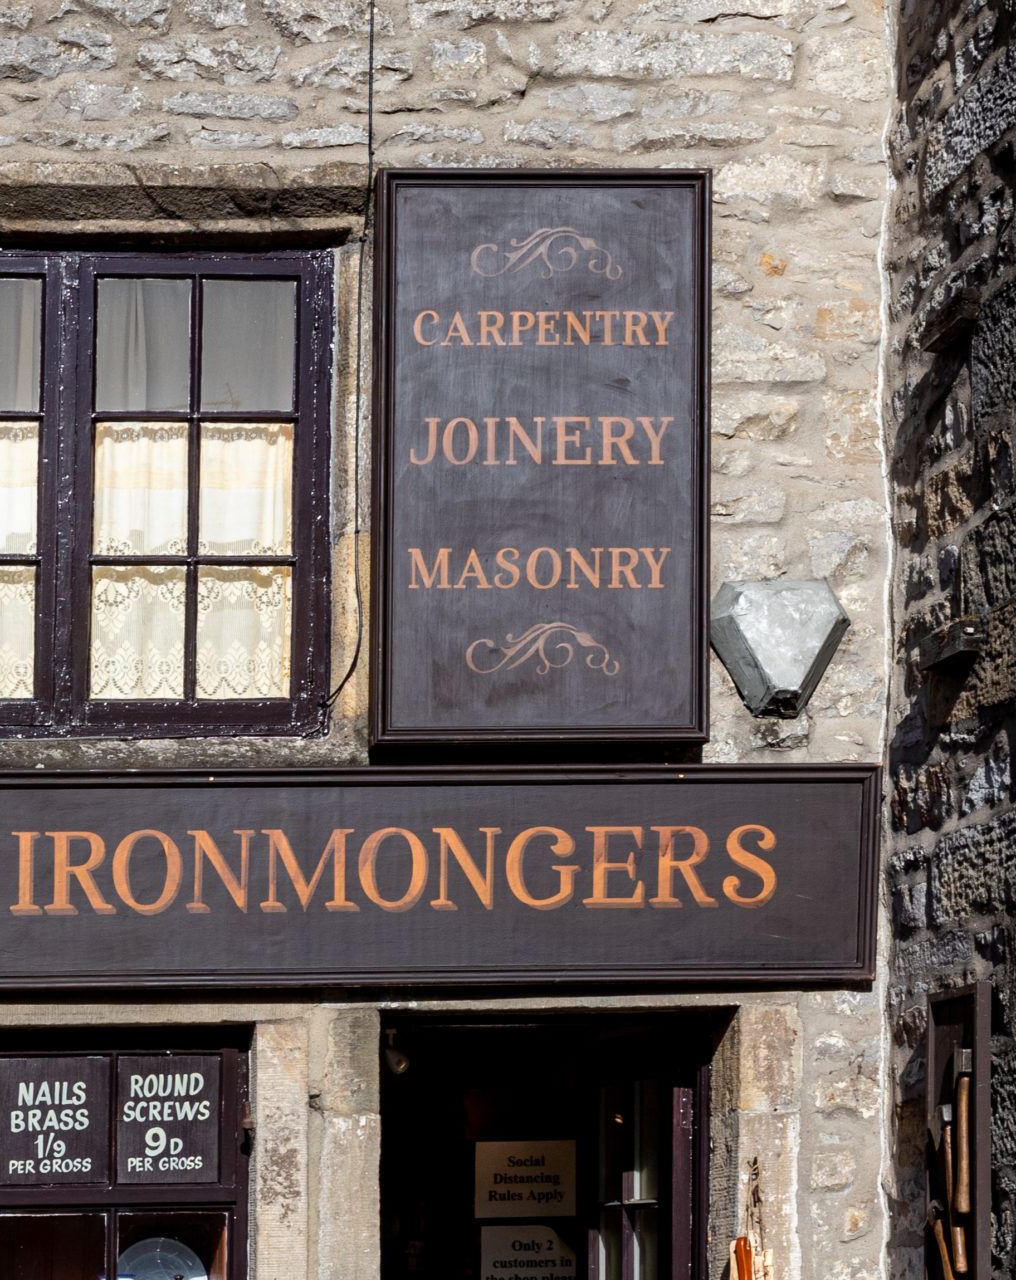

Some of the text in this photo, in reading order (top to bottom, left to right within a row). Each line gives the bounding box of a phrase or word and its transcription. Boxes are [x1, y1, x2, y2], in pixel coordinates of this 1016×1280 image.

[413, 311, 674, 346] CARPENTRY
[410, 417, 674, 465] JOINERY
[408, 548, 671, 589] MASONRY
[9, 824, 778, 916] IRONMONGERS
[17, 1081, 87, 1107] NAILS
[130, 1072, 204, 1098] ROUND
[10, 1108, 90, 1133] BRASS
[122, 1100, 211, 1122] SCREWS
[34, 1132, 66, 1159] 1/9
[9, 1157, 92, 1174] PER GROSS
[127, 1156, 204, 1172] PER GROSS
[507, 1155, 545, 1167] Social
[493, 1172, 560, 1185] Distancing
[488, 1189, 565, 1203] Rules Apply
[512, 1240, 554, 1253] Only 2
[492, 1256, 572, 1268] customers in
